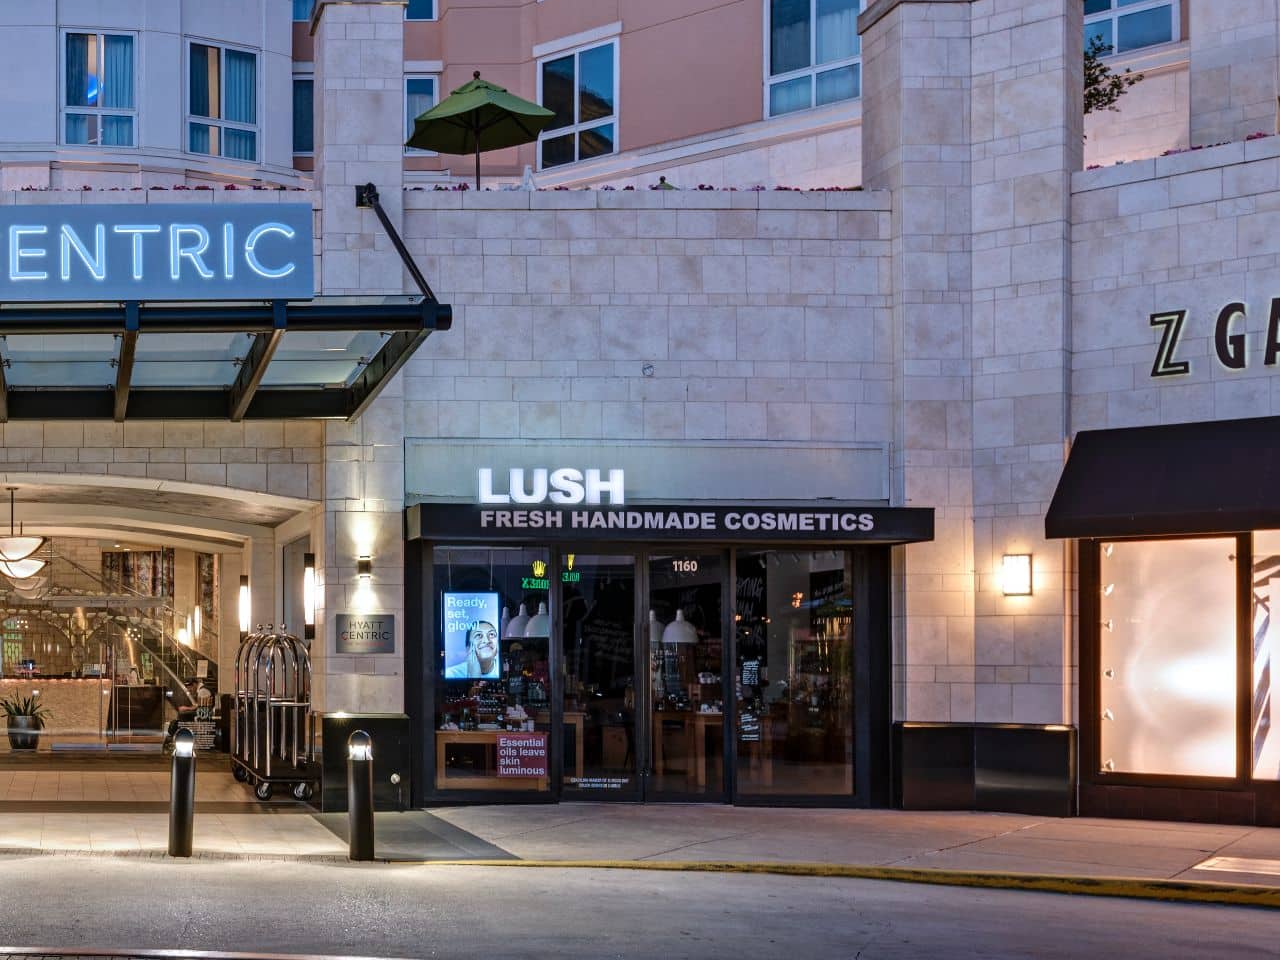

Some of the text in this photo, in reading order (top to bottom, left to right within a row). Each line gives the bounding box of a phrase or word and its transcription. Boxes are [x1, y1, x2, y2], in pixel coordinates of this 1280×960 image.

[1150, 309, 1189, 376] Z
[478, 467, 624, 505] LUSH
[480, 510, 874, 531] FRESH HANDMADE COSMETICS
[672, 560, 698, 572] 1160
[447, 596, 488, 609] Ready,
[447, 609, 470, 620] set,
[349, 620, 384, 630] HYATT
[340, 631, 392, 640] CENTRIC
[500, 738, 544, 747] Essential
[500, 748, 545, 756] oils leave
[500, 757, 520, 766] skin
[500, 766, 545, 775] luminous
